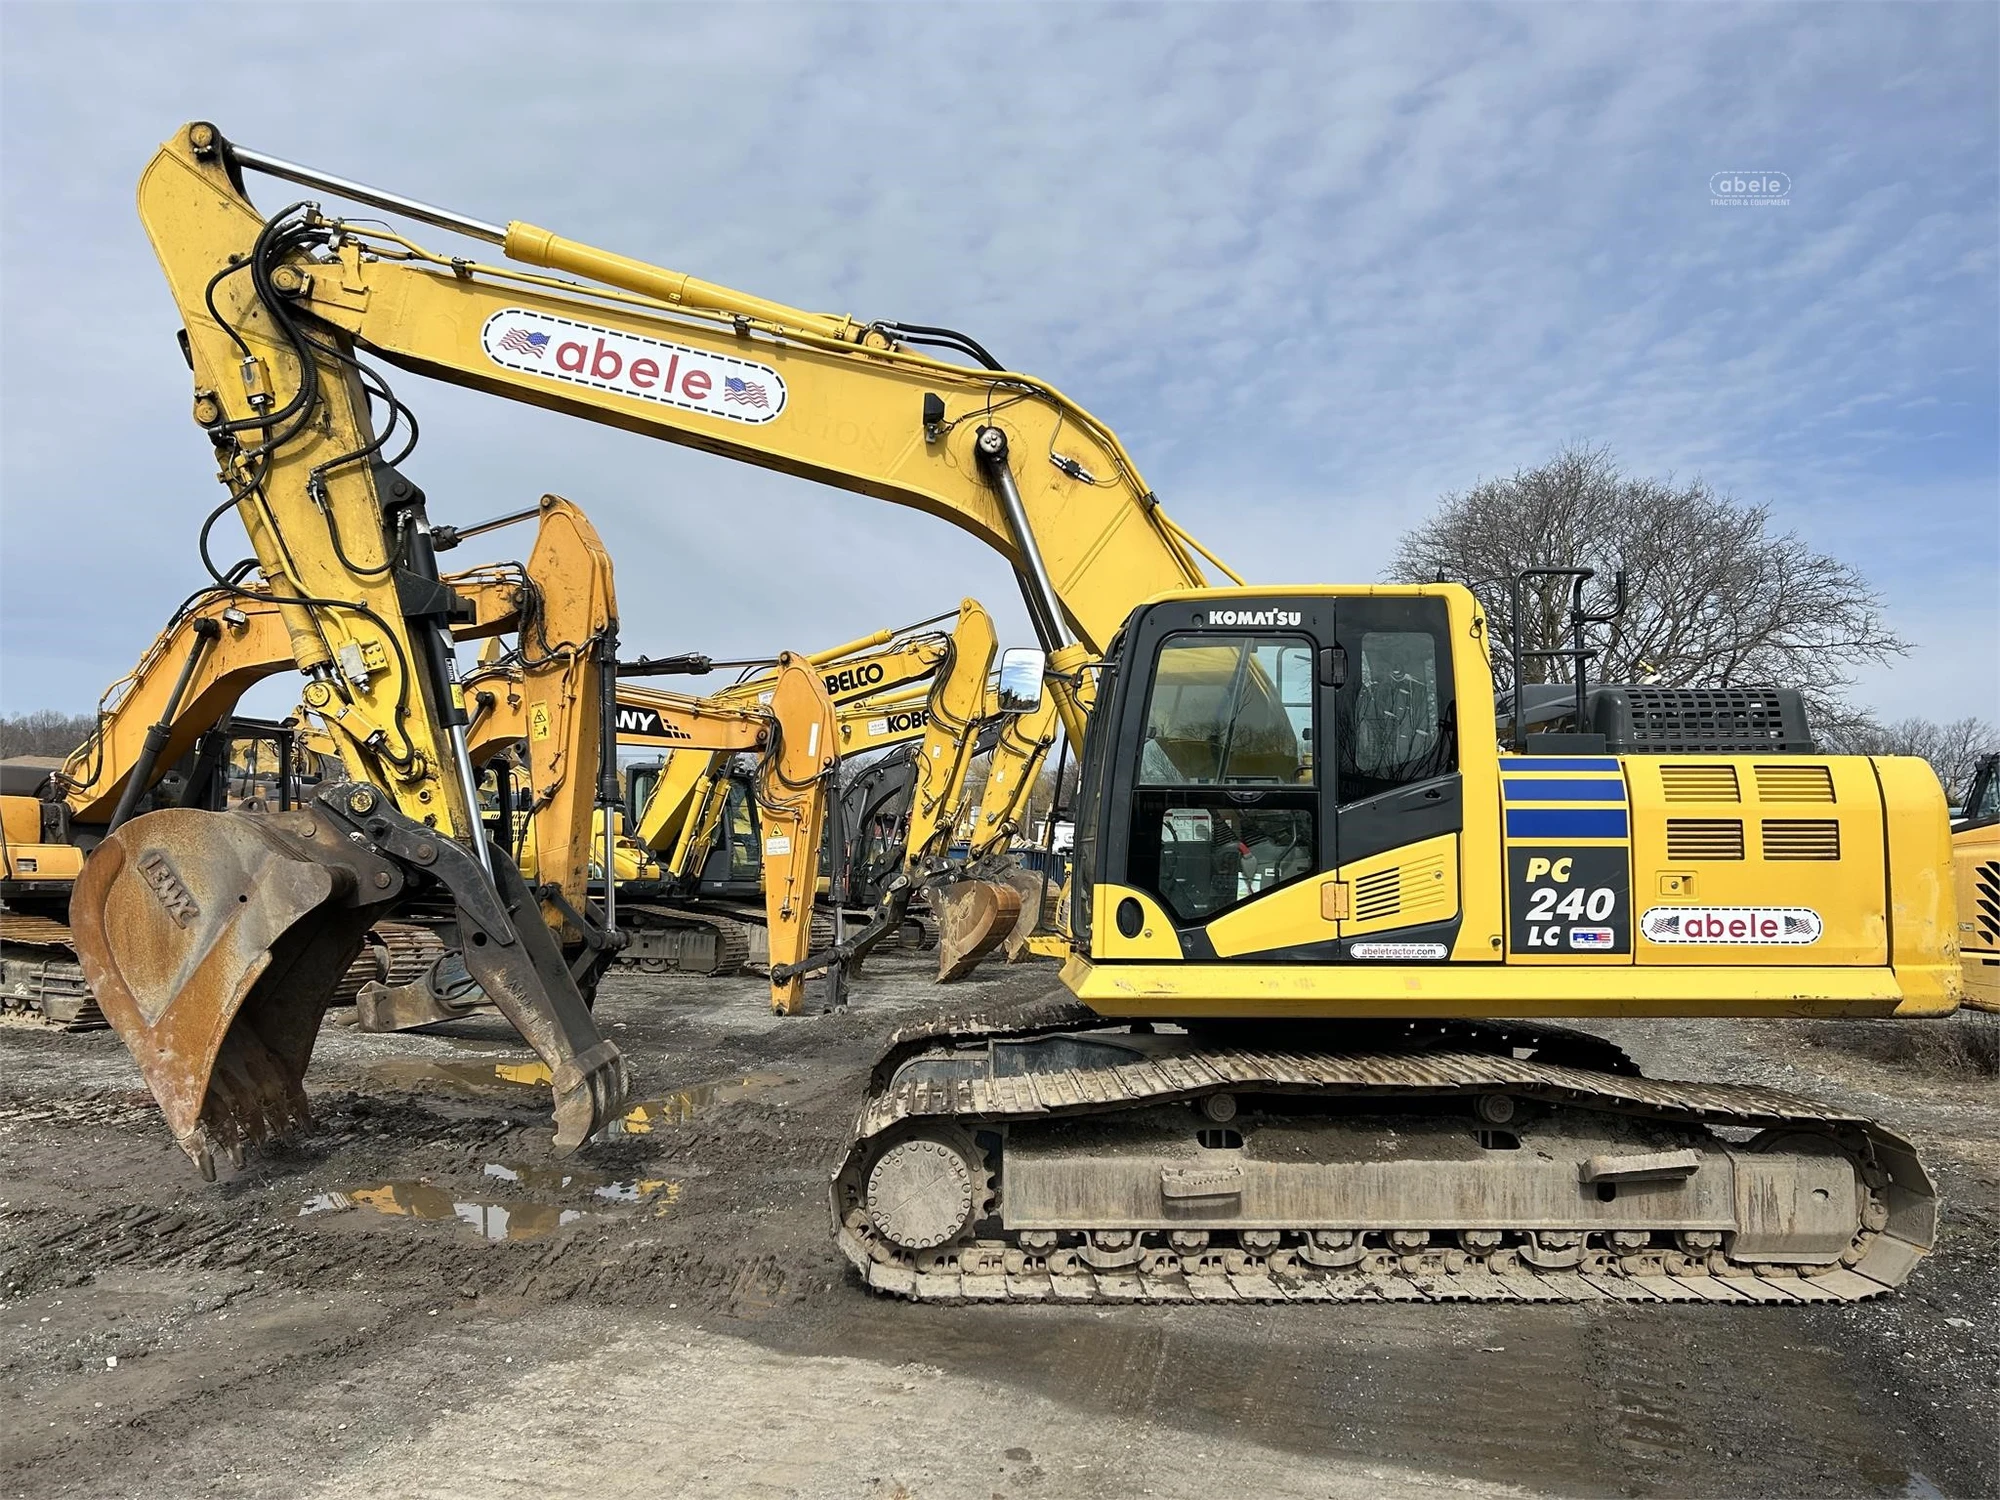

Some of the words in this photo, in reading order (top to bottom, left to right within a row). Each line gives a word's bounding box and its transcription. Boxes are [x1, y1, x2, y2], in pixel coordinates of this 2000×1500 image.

[555, 338, 713, 400] abele
[1209, 608, 1301, 626] KOMATSU
[822, 663, 884, 696] BELCO
[616, 710, 657, 732] NY
[1525, 857, 1573, 883] PC
[1525, 887, 1616, 922] 240
[1527, 925, 1561, 946] LC
[1684, 913, 1779, 938] abele
[1361, 947, 1437, 956] abeletractor.com
